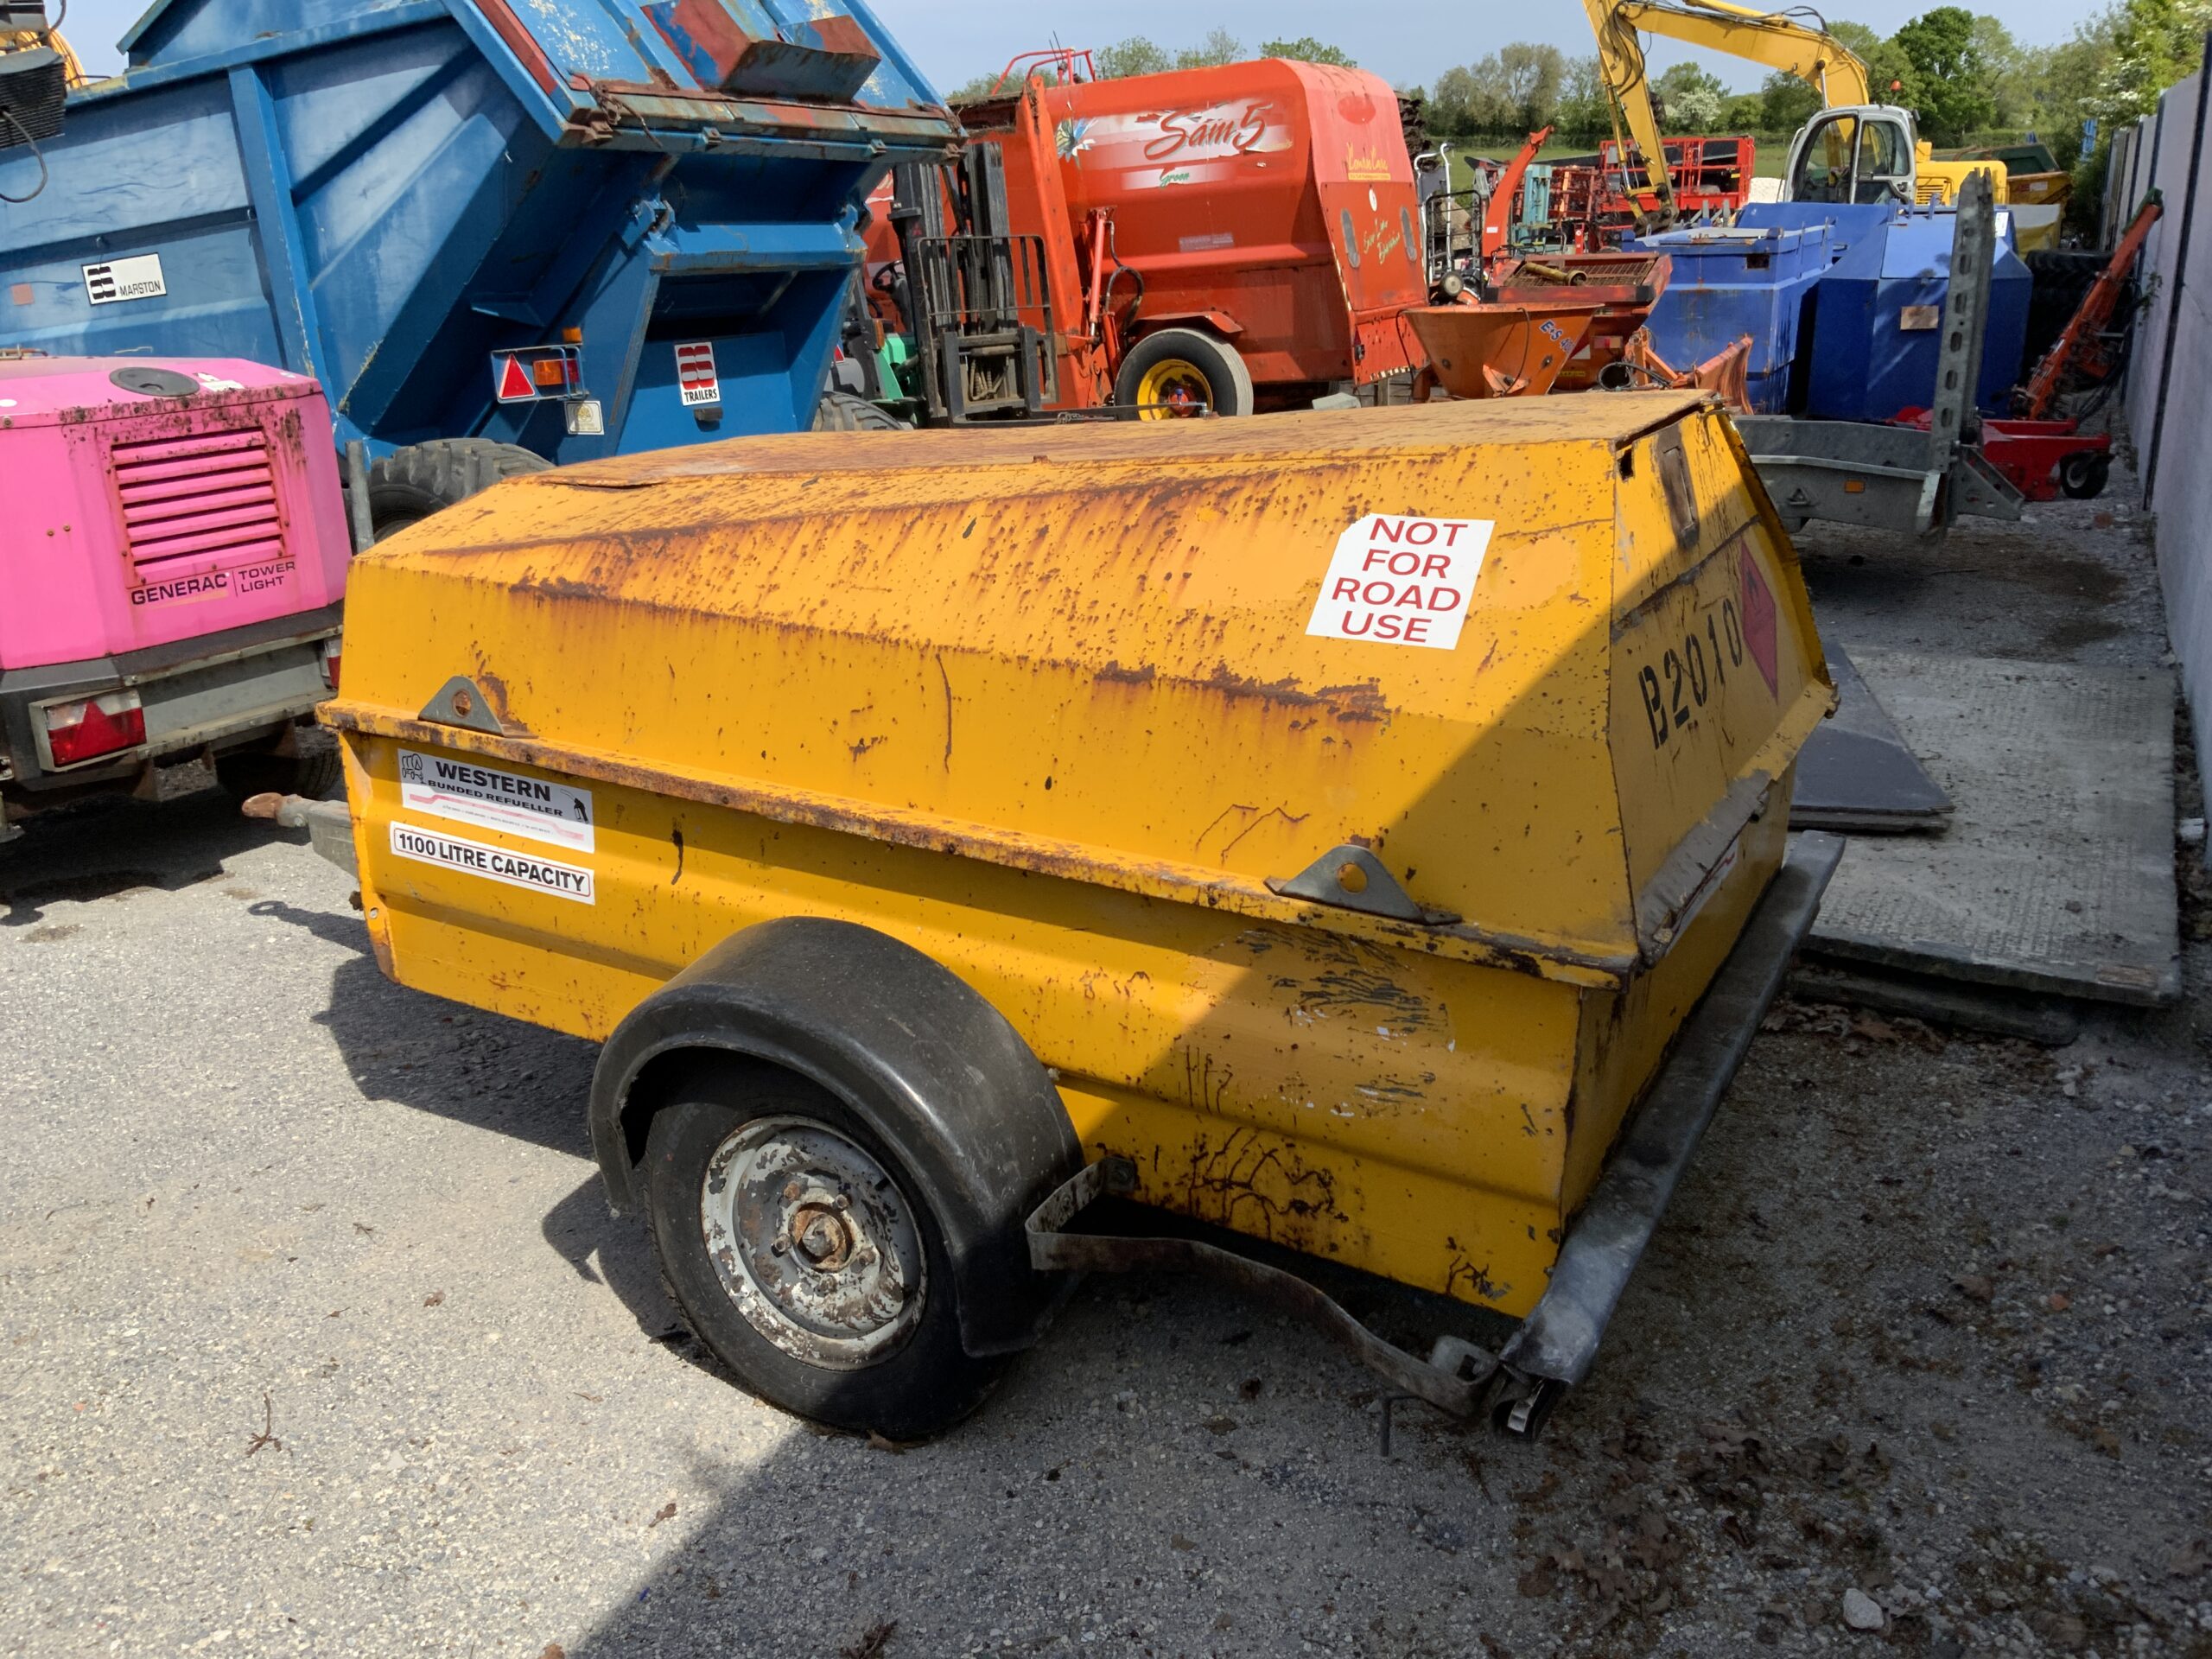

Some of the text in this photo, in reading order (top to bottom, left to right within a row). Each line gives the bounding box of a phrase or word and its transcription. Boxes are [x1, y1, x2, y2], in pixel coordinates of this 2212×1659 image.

[119, 280, 162, 296] MARSTON
[684, 388, 718, 403] TRAILERS
[1369, 518, 1469, 547] NOT
[238, 561, 296, 581] TOWER
[1362, 548, 1452, 579] FOR
[130, 573, 228, 605] GENERAC
[241, 575, 286, 593] LIGHT
[1332, 576, 1461, 612] ROAD
[1341, 610, 1432, 643] USE
[1638, 598, 1743, 751] B2010
[435, 760, 551, 803] WESTERN
[428, 779, 564, 817] BUNDED REFUELLER
[398, 833, 586, 892] 1100 LITRE CAPACITY
